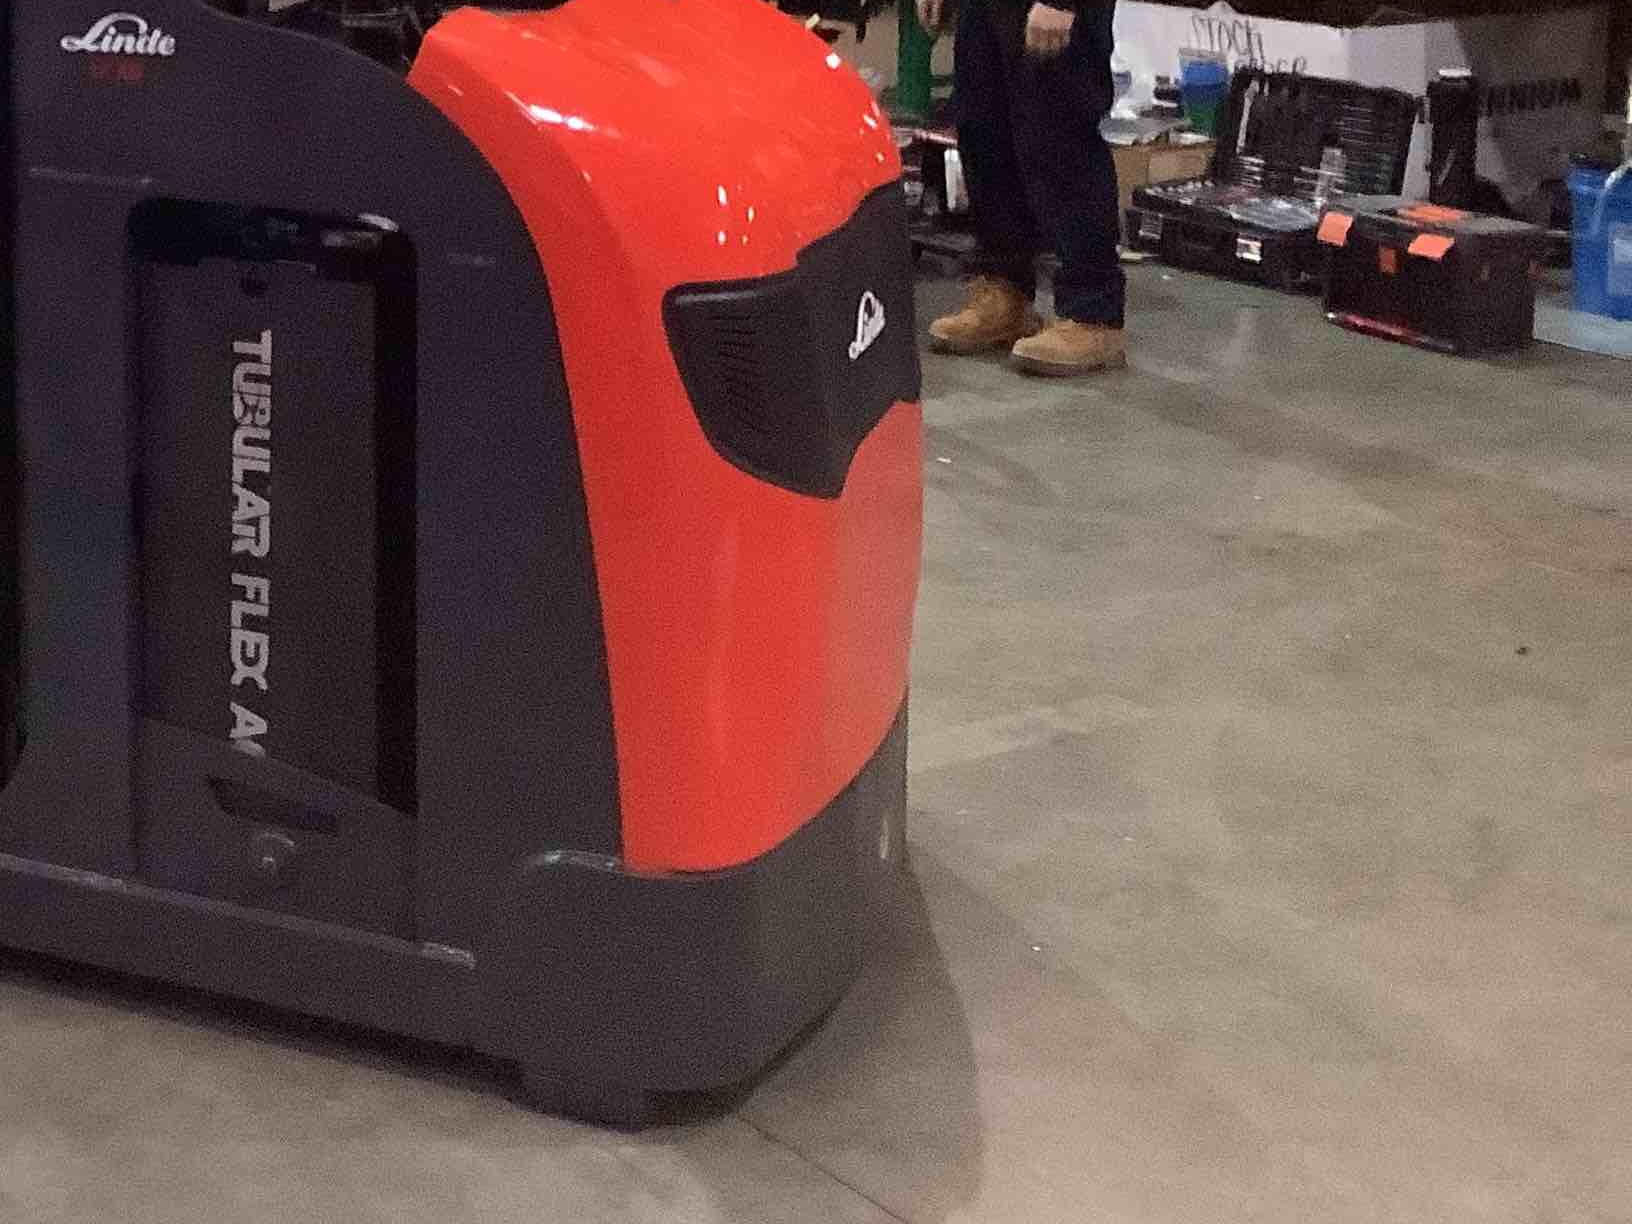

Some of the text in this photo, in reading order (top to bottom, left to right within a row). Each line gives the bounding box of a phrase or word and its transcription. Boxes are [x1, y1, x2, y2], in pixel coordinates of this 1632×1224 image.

[60, 12, 176, 56] Linde
[231, 328, 272, 558] TUBULAR
[229, 572, 269, 691] FLEX
